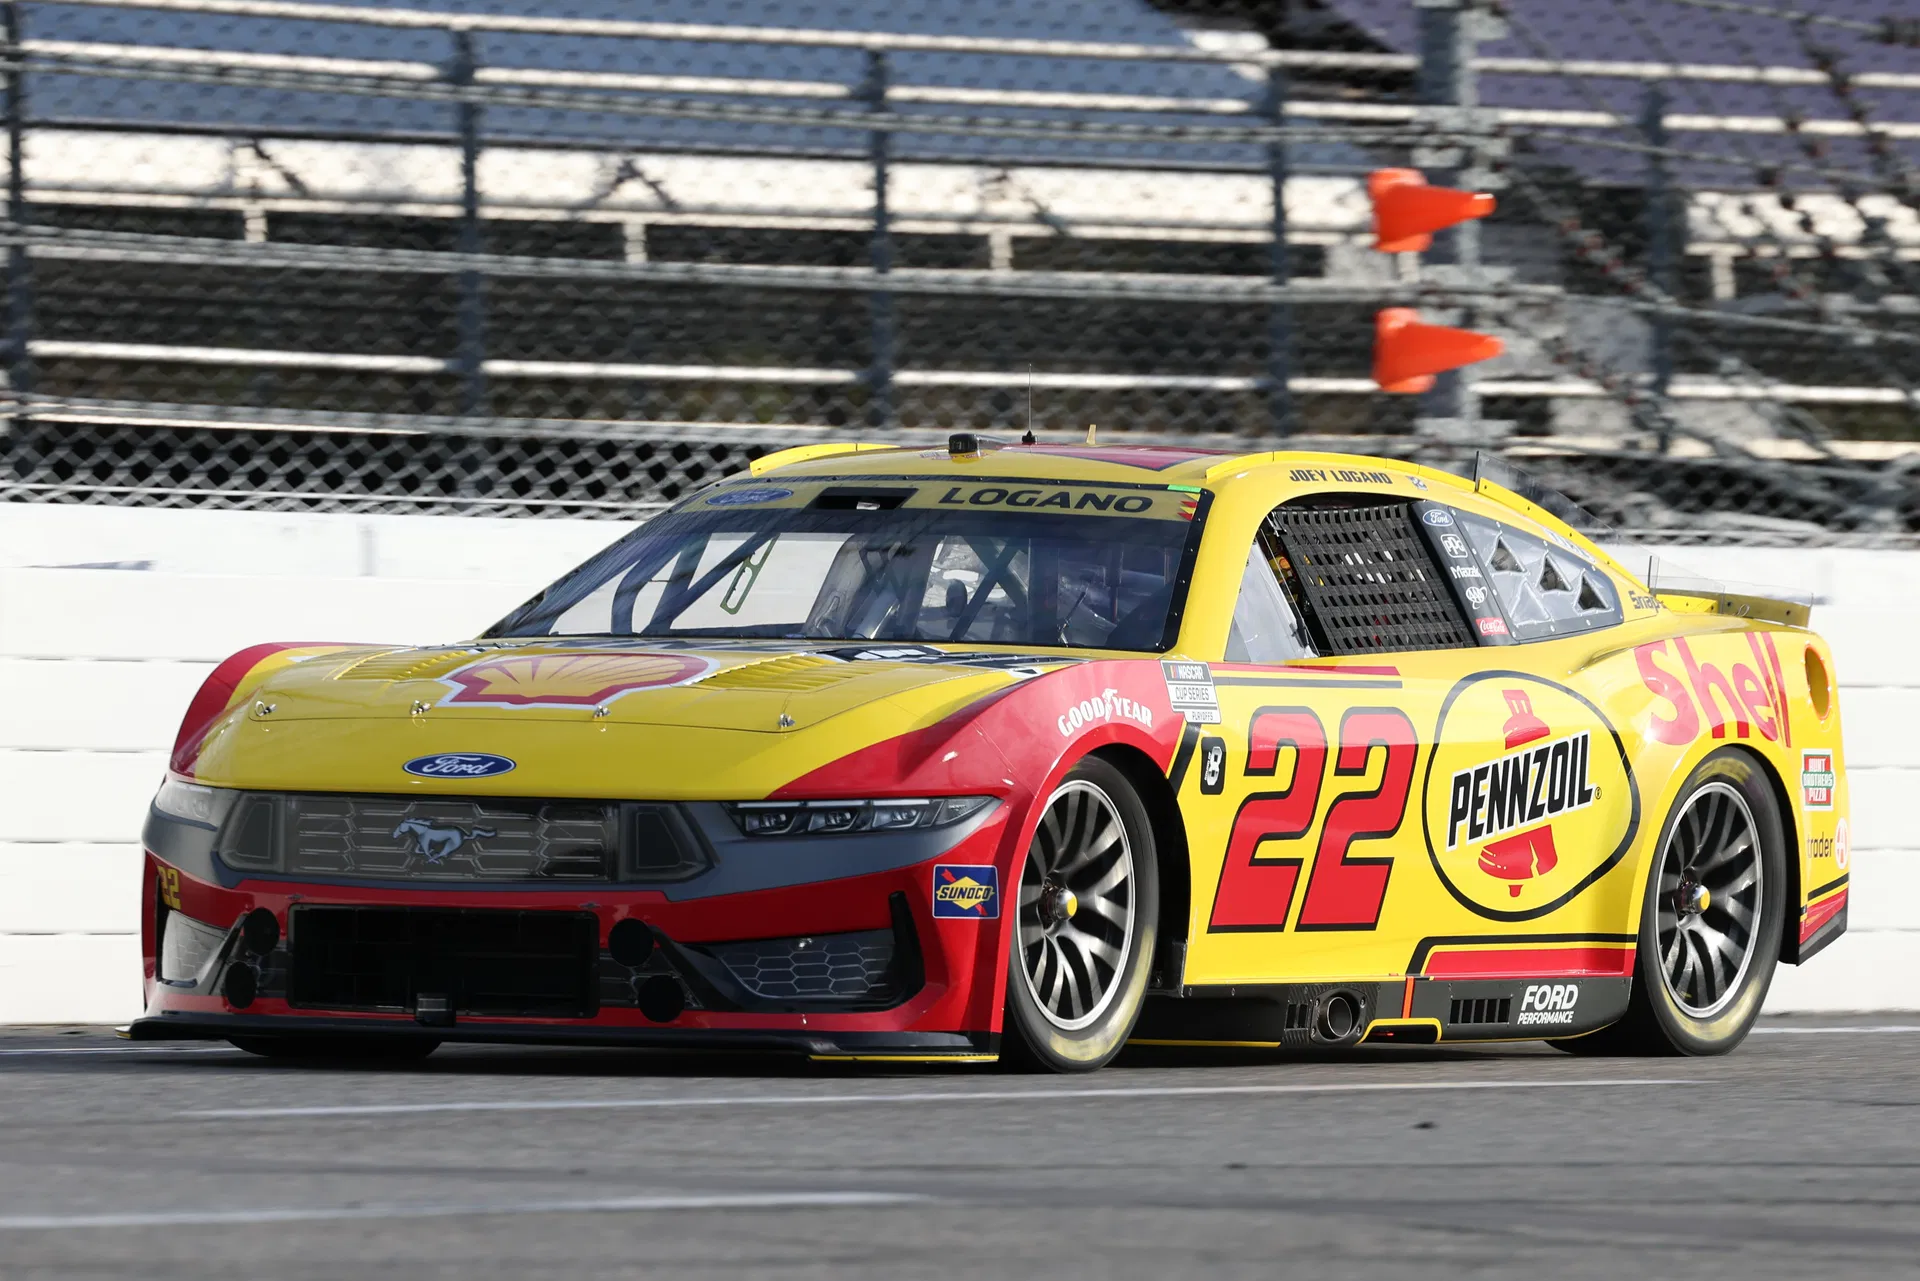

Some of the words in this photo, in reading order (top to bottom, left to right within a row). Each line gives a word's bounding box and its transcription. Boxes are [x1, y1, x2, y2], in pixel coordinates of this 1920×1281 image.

[1289, 469, 1328, 482] JOEY
[1329, 469, 1393, 484] LOGANO
[938, 487, 1153, 513] LOGANO
[1449, 565, 1482, 579] Mazak
[1178, 665, 1204, 680] NASCAR
[1175, 687, 1188, 700] CUP
[1188, 687, 1209, 701] SERIES
[1634, 631, 1791, 748] Shell
[1191, 711, 1214, 720] PLAYOFFS
[422, 756, 495, 774] Ford
[1803, 773, 1833, 787] BROTHERS
[1447, 733, 1594, 848] PENNZOIL
[1808, 788, 1827, 802] PIZZA
[1207, 706, 1419, 934] 22
[939, 886, 992, 900] SUNOCO
[1521, 984, 1579, 1011] FORD
[1517, 1010, 1574, 1024] PERFORMANCE
